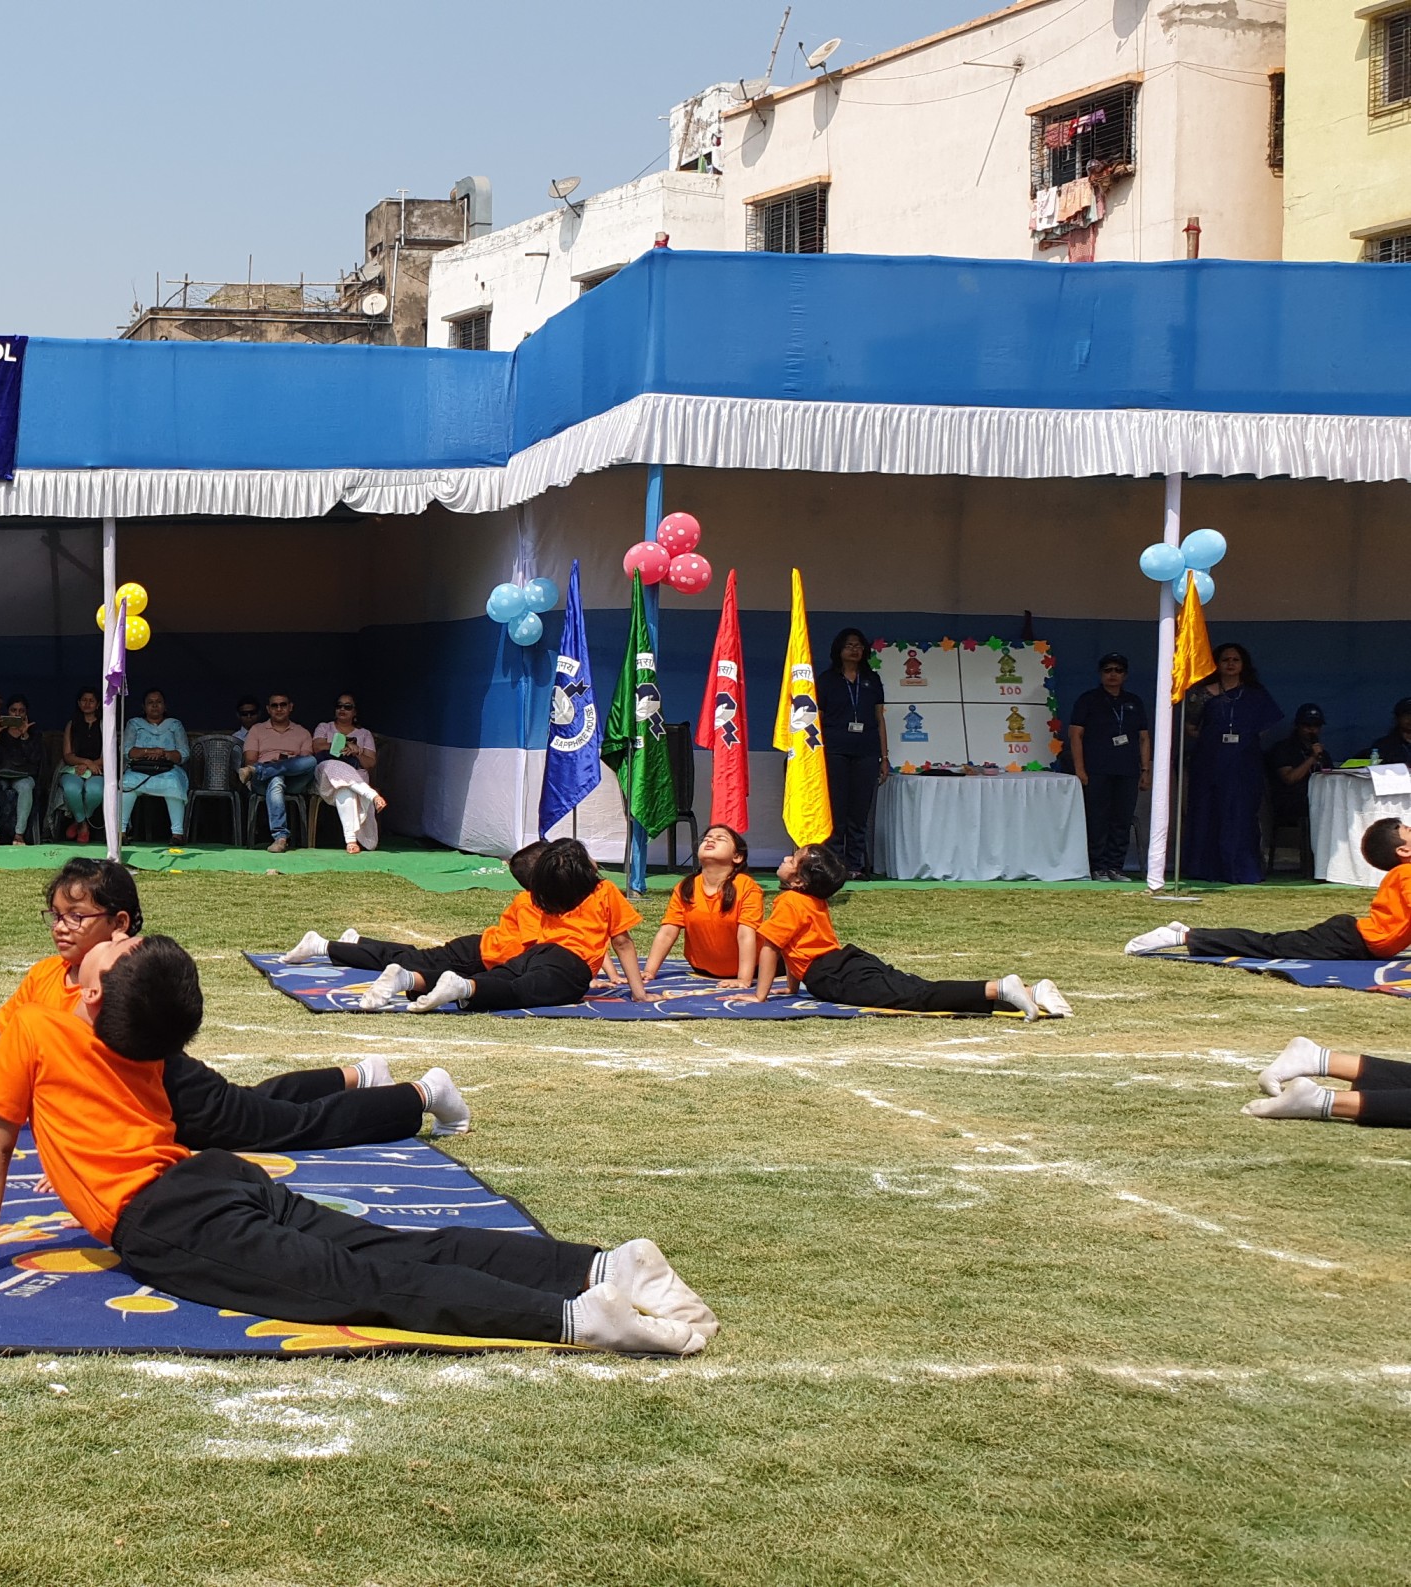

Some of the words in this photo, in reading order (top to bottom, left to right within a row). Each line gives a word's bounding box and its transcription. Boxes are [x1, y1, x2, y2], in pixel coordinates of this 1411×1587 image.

[999, 685, 1022, 696] 100
[553, 732, 589, 749] SAPPHIRE
[585, 706, 595, 733] HOUSE
[1007, 743, 1029, 754] 100
[377, 1207, 460, 1217] EARTH
[4, 1274, 70, 1298] VENUS
